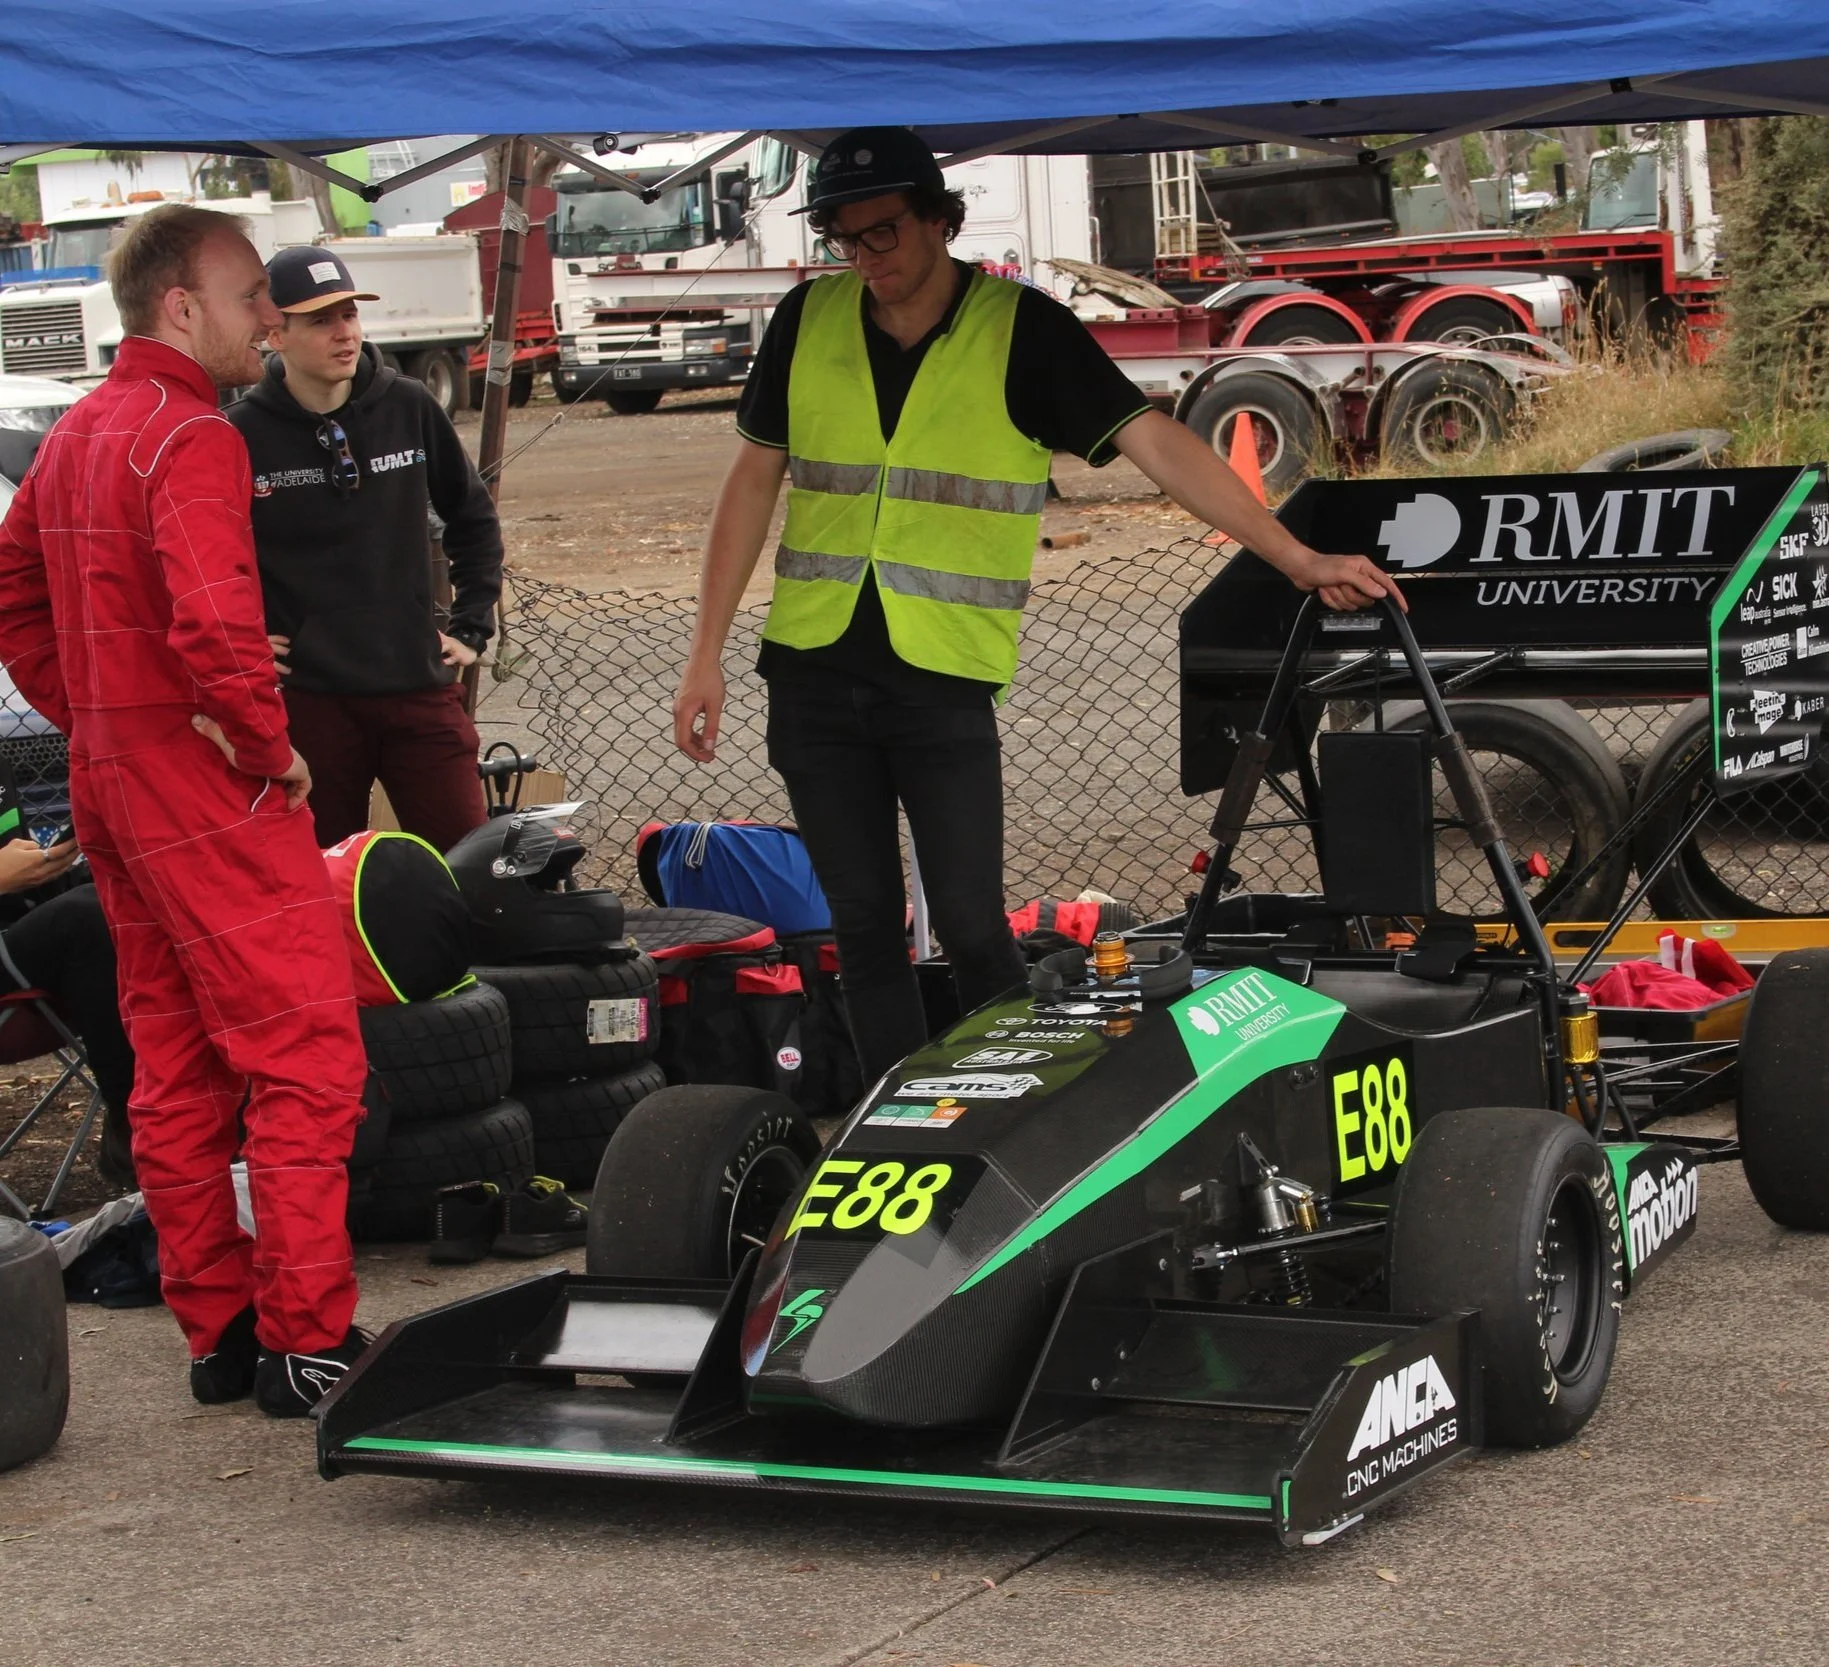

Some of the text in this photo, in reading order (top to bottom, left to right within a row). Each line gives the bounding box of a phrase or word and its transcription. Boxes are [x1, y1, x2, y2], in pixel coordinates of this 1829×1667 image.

[5, 334, 80, 348] MACK
[270, 468, 324, 479] THE UNIVERSITY
[276, 474, 326, 489] ADELAIDE
[1469, 486, 1735, 562] RMIT
[1780, 533, 1809, 560] SKF
[1477, 577, 1715, 606] UNIVERSITY
[1772, 572, 1798, 601] SICK
[1742, 638, 1768, 658] CREATIVE
[1768, 632, 1790, 651] POWER
[1745, 652, 1788, 676] TECHNOLOGIES
[1802, 696, 1825, 714] KABER
[1724, 754, 1743, 780] FILA
[1204, 972, 1278, 1026] RMIT
[1015, 1031, 1086, 1039] BOSCH
[1031, 1018, 1107, 1026] TOYOTA
[1235, 1003, 1291, 1041] UNIVERSITY
[780, 1052, 799, 1064] BELL
[970, 1051, 1042, 1060] SAE
[1333, 1057, 1411, 1182] E88
[784, 1160, 952, 1241] E88
[1627, 1169, 1659, 1215] ANCA
[1628, 1166, 1698, 1272] motion
[1347, 1354, 1456, 1462] ANCA
[1347, 1418, 1457, 1497] CNC MACHINES
